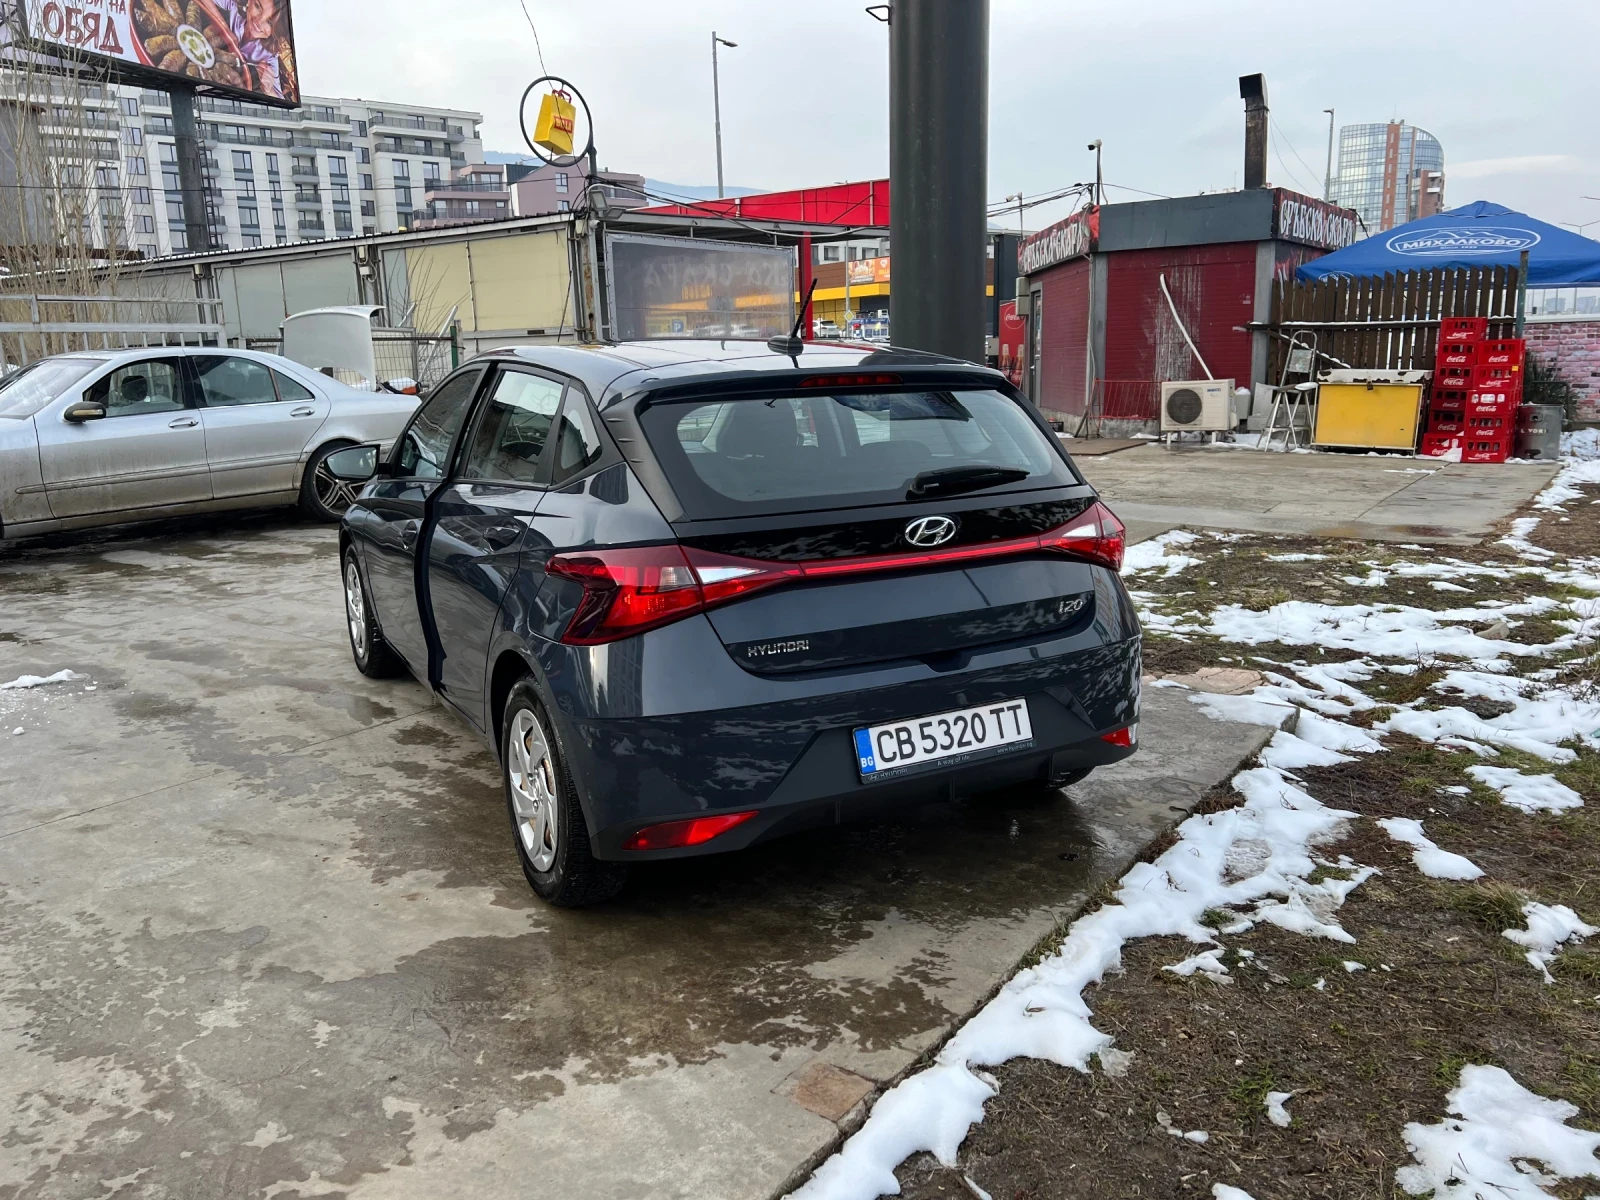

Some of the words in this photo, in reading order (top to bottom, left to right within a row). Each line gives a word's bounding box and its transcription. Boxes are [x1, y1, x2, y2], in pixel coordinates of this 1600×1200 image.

[43, 2, 124, 54] ОБЯД
[1403, 238, 1521, 249] МИХАЛКОВО
[748, 640, 809, 658] HYUNDAI
[876, 726, 916, 763] CB
[918, 712, 986, 754] 5320
[990, 704, 1022, 739] TT
[860, 756, 874, 768] BG
